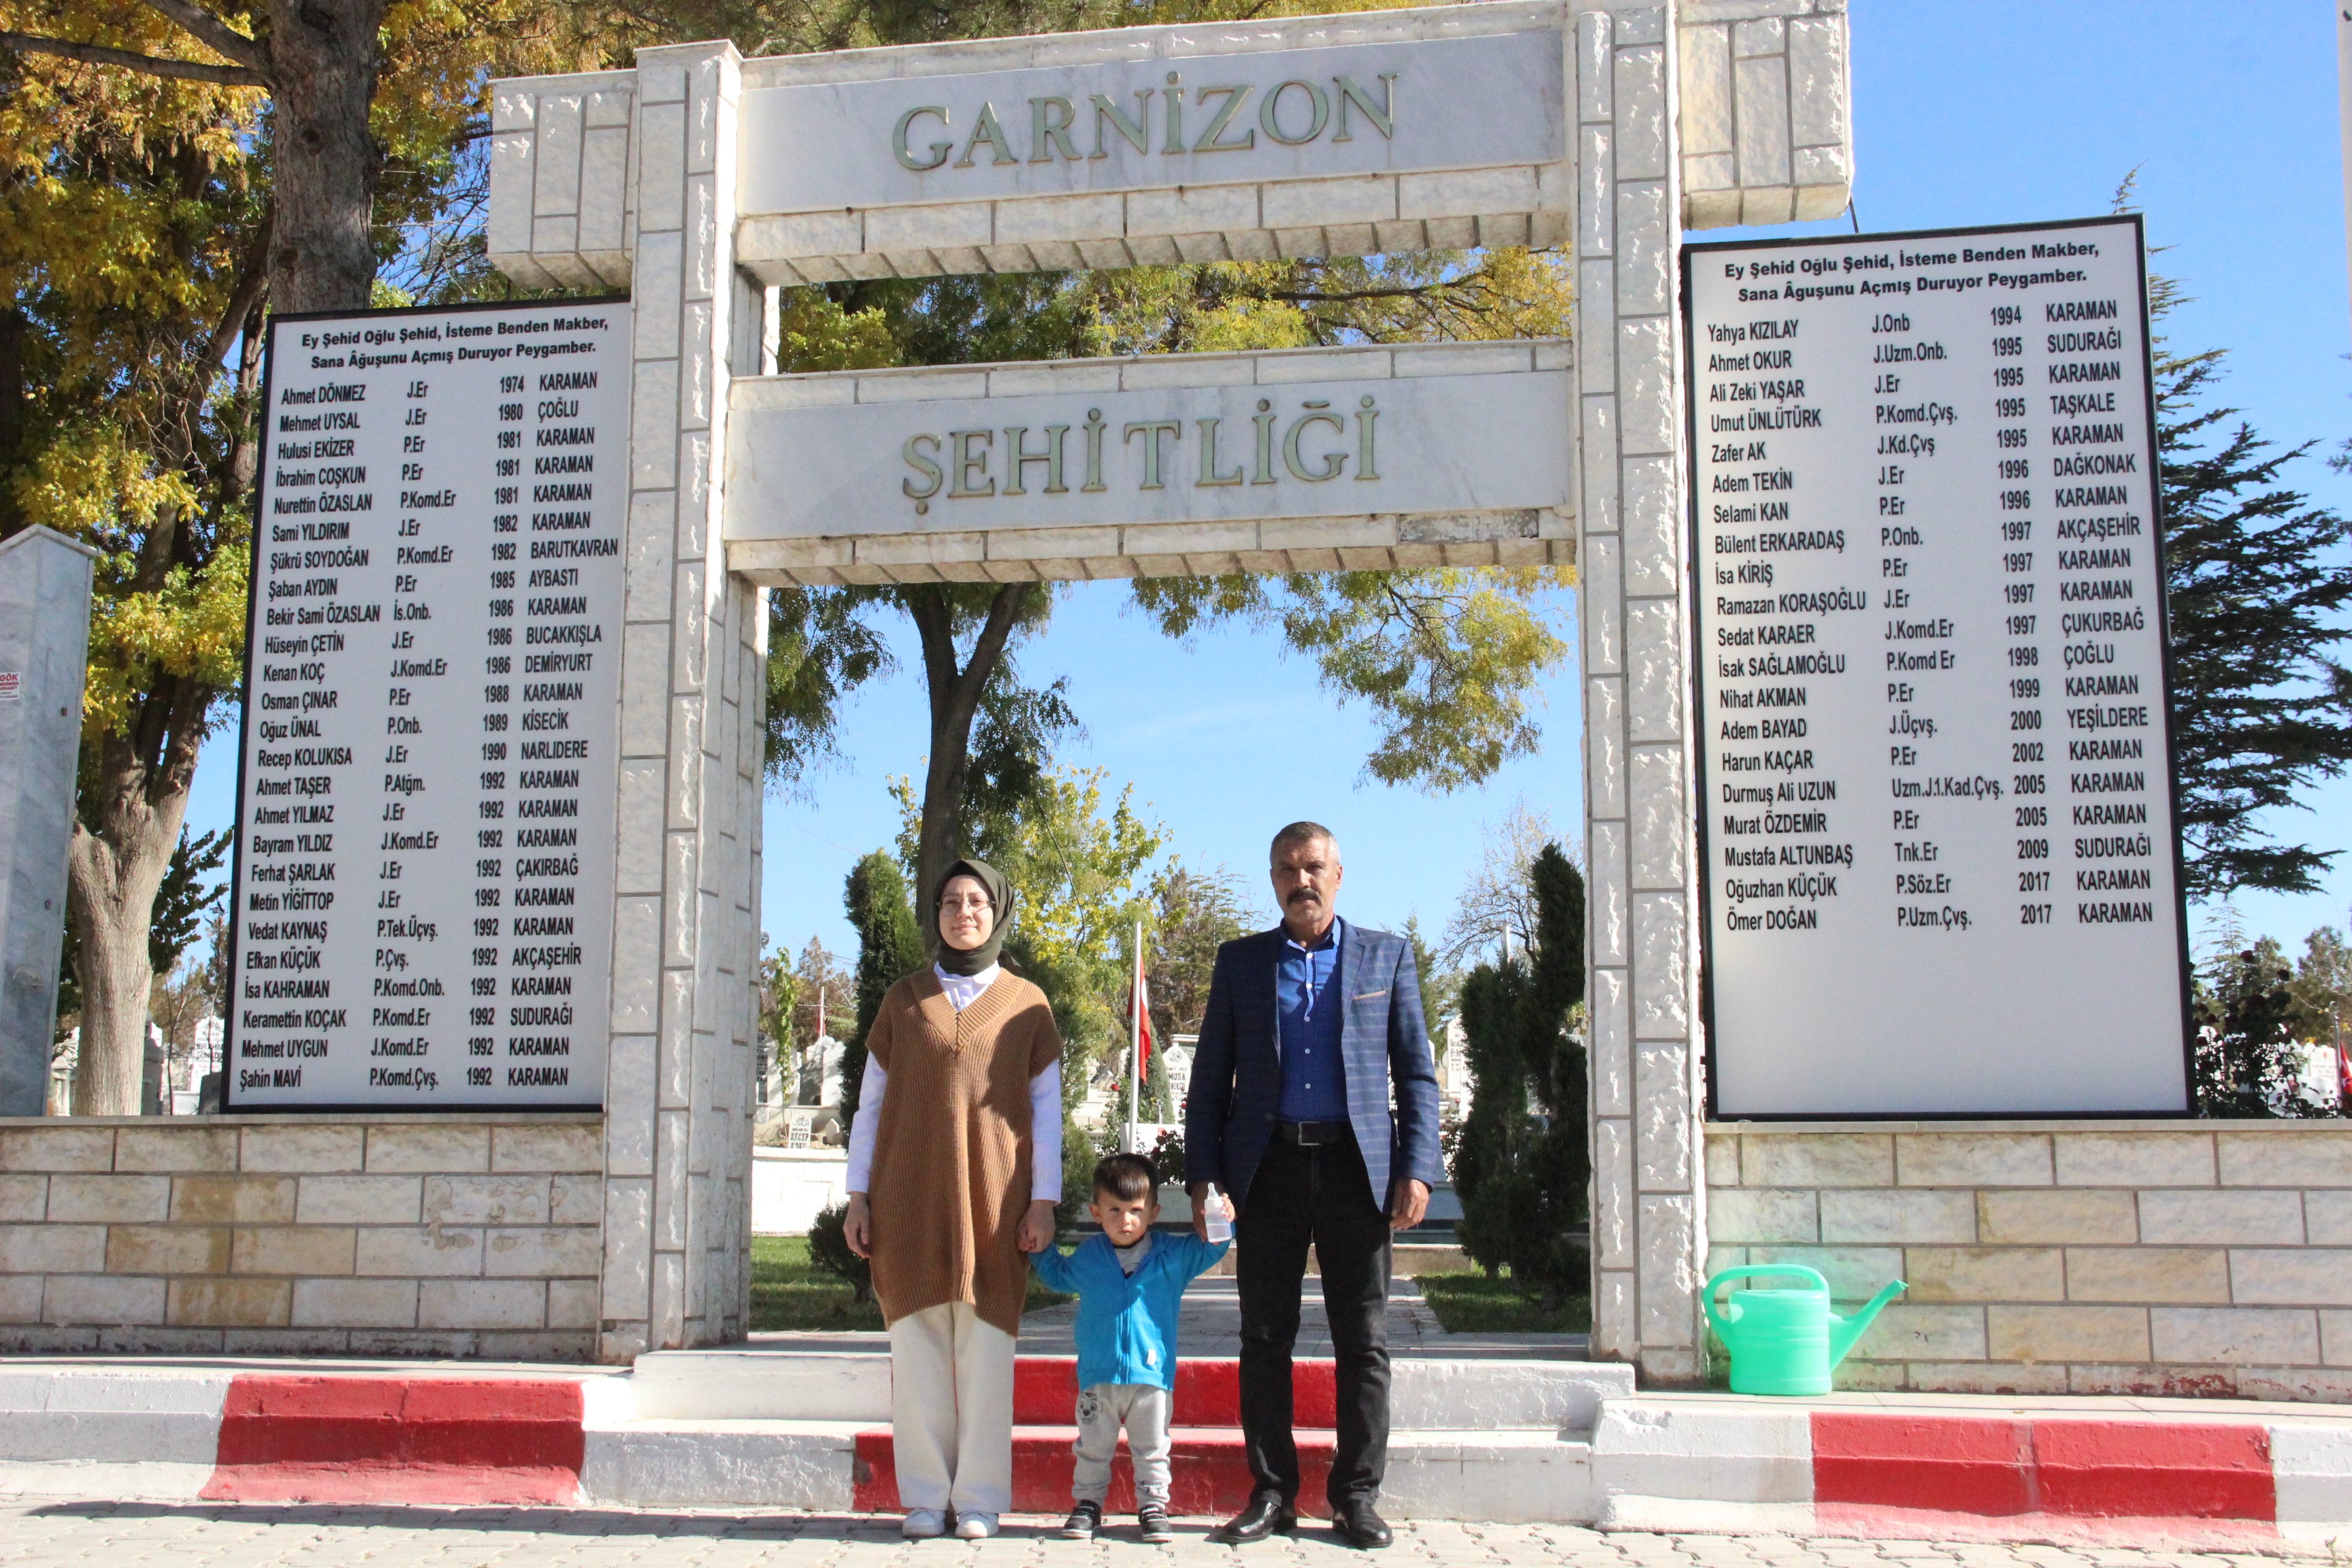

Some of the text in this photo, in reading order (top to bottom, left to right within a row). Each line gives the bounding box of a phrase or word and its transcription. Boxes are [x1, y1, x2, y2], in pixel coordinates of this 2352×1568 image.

[892, 70, 1399, 172] GARNİZON
[1725, 242, 2100, 281] Ey Şehid Oğlu Şehid, İsteme Benden Makber,
[1737, 288, 1779, 303] Sana
[1859, 280, 1912, 297] Açmış
[1916, 276, 1984, 293] Duruyor
[1987, 268, 2087, 290] Peygamber.
[301, 316, 608, 350] Ey Şehid Oğlu Şehid, İsteme Benden Makber,
[1707, 299, 2117, 346] Yahya KIZILAY J.Onb 1994 KARAMAN
[310, 355, 345, 370] Sana
[410, 350, 454, 365] Açmış
[457, 347, 513, 362] Duruyor
[515, 340, 597, 359] Peygamber.
[280, 371, 598, 406] Ahmet DÖNMEZ J.Er 1974 KARAMAN
[1709, 361, 2121, 404] Ali Zeki YAŞAR J.Er 1995 KARAMAN
[277, 426, 595, 460] Hulusi EKİZER P.Er 1981 KARAMAN
[901, 394, 1382, 516] ŞEHİTLİĞİ
[1711, 423, 2124, 463] Zafer AK J.Kd.Çvş 1995 KARAMAN
[274, 483, 593, 515] Nurettin ÖZASLAN P.Komd.Er 1981 KARAMAN
[1713, 485, 2128, 524] Selami KAN P.Er 1996 KARAMAN
[270, 538, 619, 575] Şükrü SOYDOĞAN P.Komd.Er 1982 BARUTKAVRAN
[1715, 547, 2132, 588] İsa KİRİŞ P.Er 1997 KARAMAN
[264, 624, 602, 658] Hüseyin ÇETİN J.Er 1986 BUCAKKIŞLA
[1717, 605, 2144, 647] Sedat KARAER J.Komd.Er 1997 ÇUKURBAĞ
[263, 650, 593, 685] Kenan KOÇ J.Komd.Er 1986 DEMİRYURT
[1720, 674, 2139, 709] Nihat AKMAN P.Er 1999 KARAMAN
[259, 707, 569, 744] Oğuz ÜNAL P.Onb. 1989 KİSECİK
[1722, 738, 2143, 775] Harun KAÇAR P.Er 2002 KARAMAN
[255, 769, 580, 800] Ahmet TAŞER P.Atğm. 1992 KARAMAN
[1723, 803, 2147, 835] Murat ÖZDEMİR P.Er 2005 KARAMAN
[252, 828, 577, 858] Bayram YILDIZ J.Komd.Er 1992 KARAMAN
[249, 887, 575, 911] Metin YİĞİTTOP J.Er 1992 KARAMAN
[1725, 868, 2151, 904] Oğuzhan KÜÇÜK P.Söz.Er 2017 KARAMAN
[246, 941, 582, 974] Efkan KÜÇÜK P.Çvş. 1992 AKÇAŞEHİR
[242, 1001, 573, 1033] Keramettin KOÇAK P.Komd.Er 1992 SUDURAĞI
[240, 1064, 569, 1093] Şahin MAVİ P.Komd.Çvş. 1992 KARAMAN
